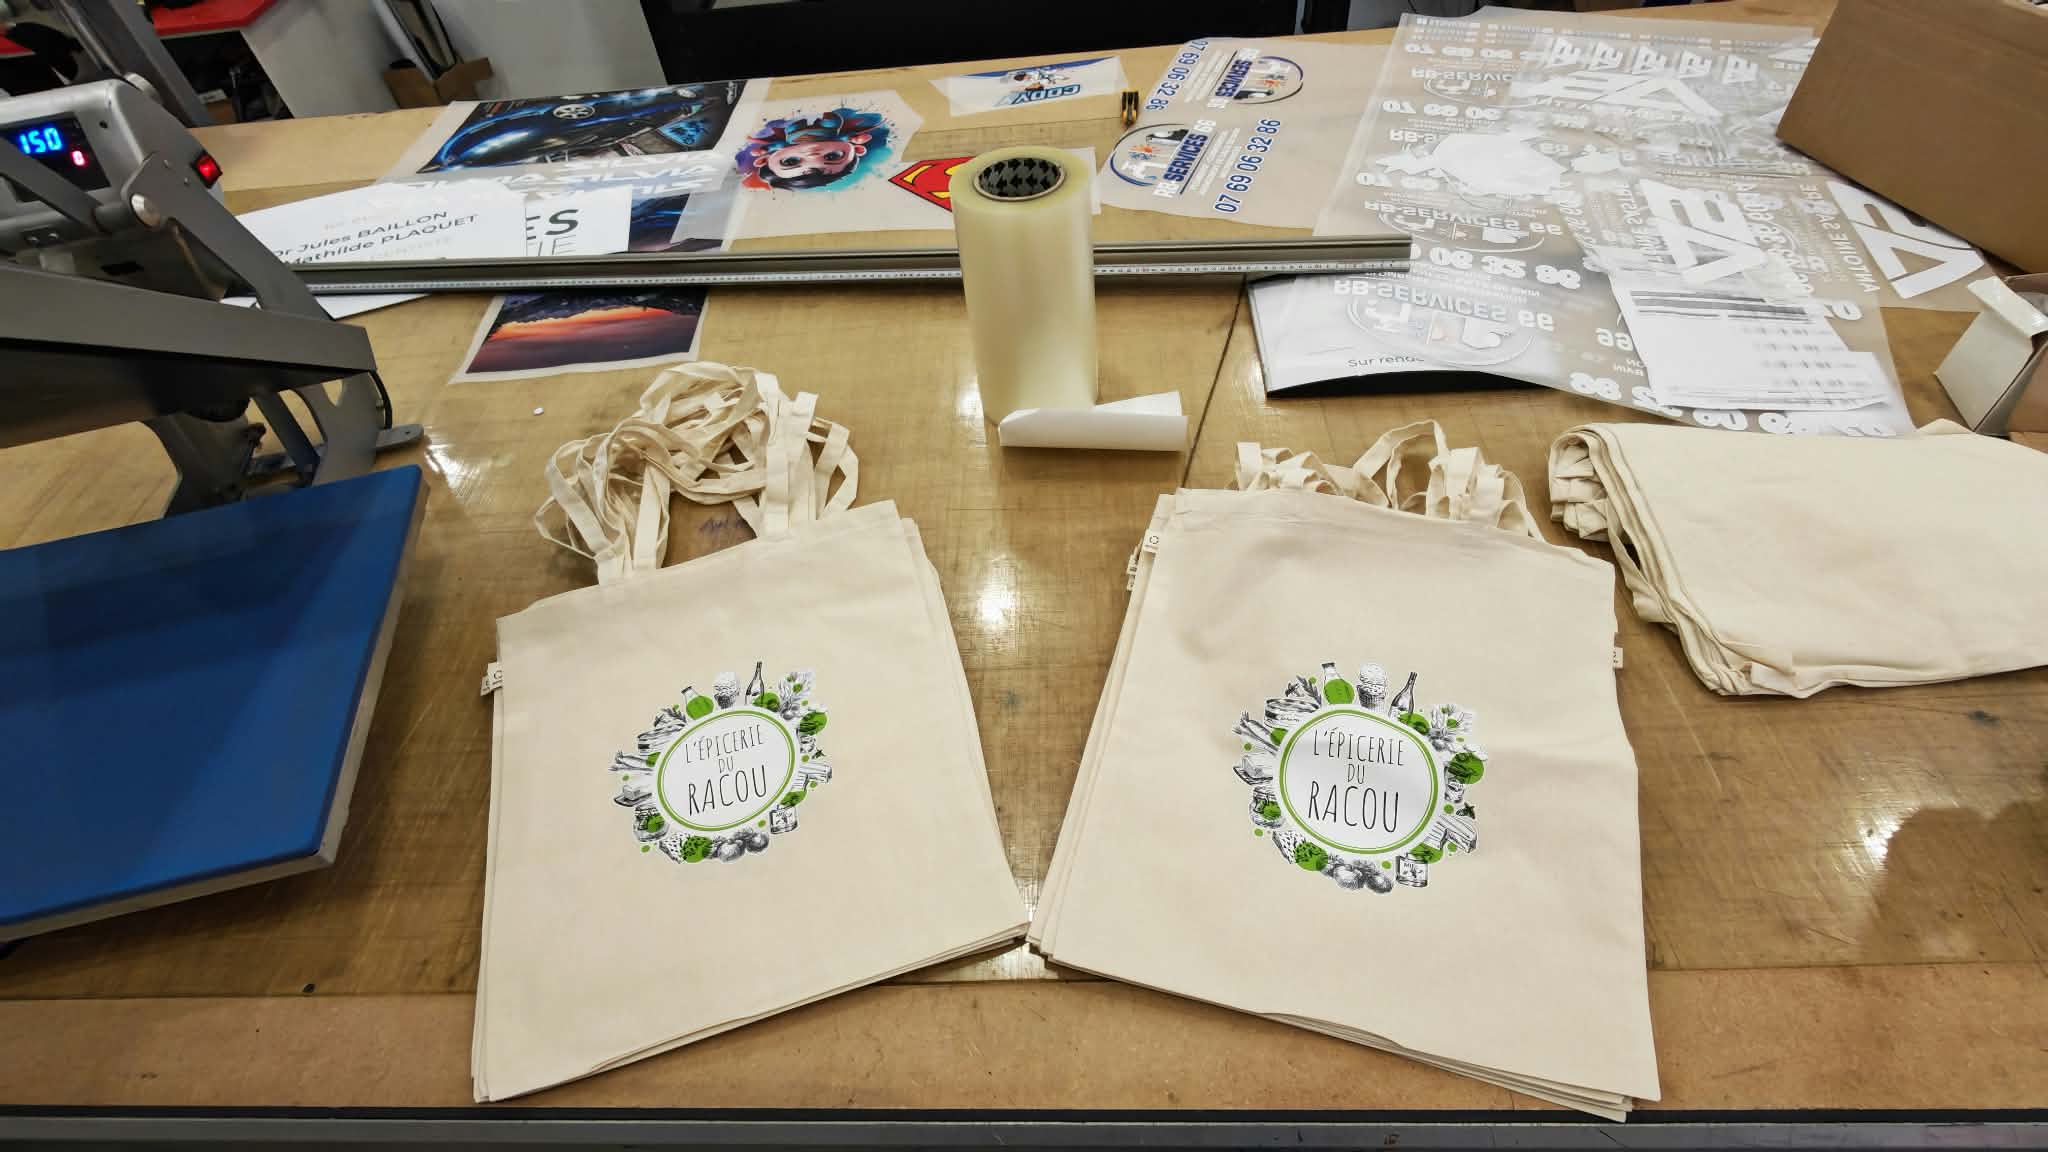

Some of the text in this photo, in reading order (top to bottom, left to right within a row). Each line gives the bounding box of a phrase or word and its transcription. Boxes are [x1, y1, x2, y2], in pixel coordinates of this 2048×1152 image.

[1178, 52, 1200, 66] 69
[1167, 67, 1189, 81] 06
[1156, 81, 1179, 97] 32
[1145, 98, 1169, 111] 86
[1257, 118, 1281, 134] 86
[19, 127, 62, 154] 150
[1247, 136, 1273, 153] 32
[1236, 155, 1265, 172] 06
[1226, 174, 1253, 193] 69
[1213, 193, 1243, 214] 07
[299, 234, 351, 251] Jules
[358, 211, 448, 239] BAILLON
[381, 213, 479, 244] PLAQUET
[719, 756, 735, 773] DU
[1347, 763, 1366, 785] DU
[688, 764, 768, 817] RACOU
[1308, 780, 1400, 833] RACOU
